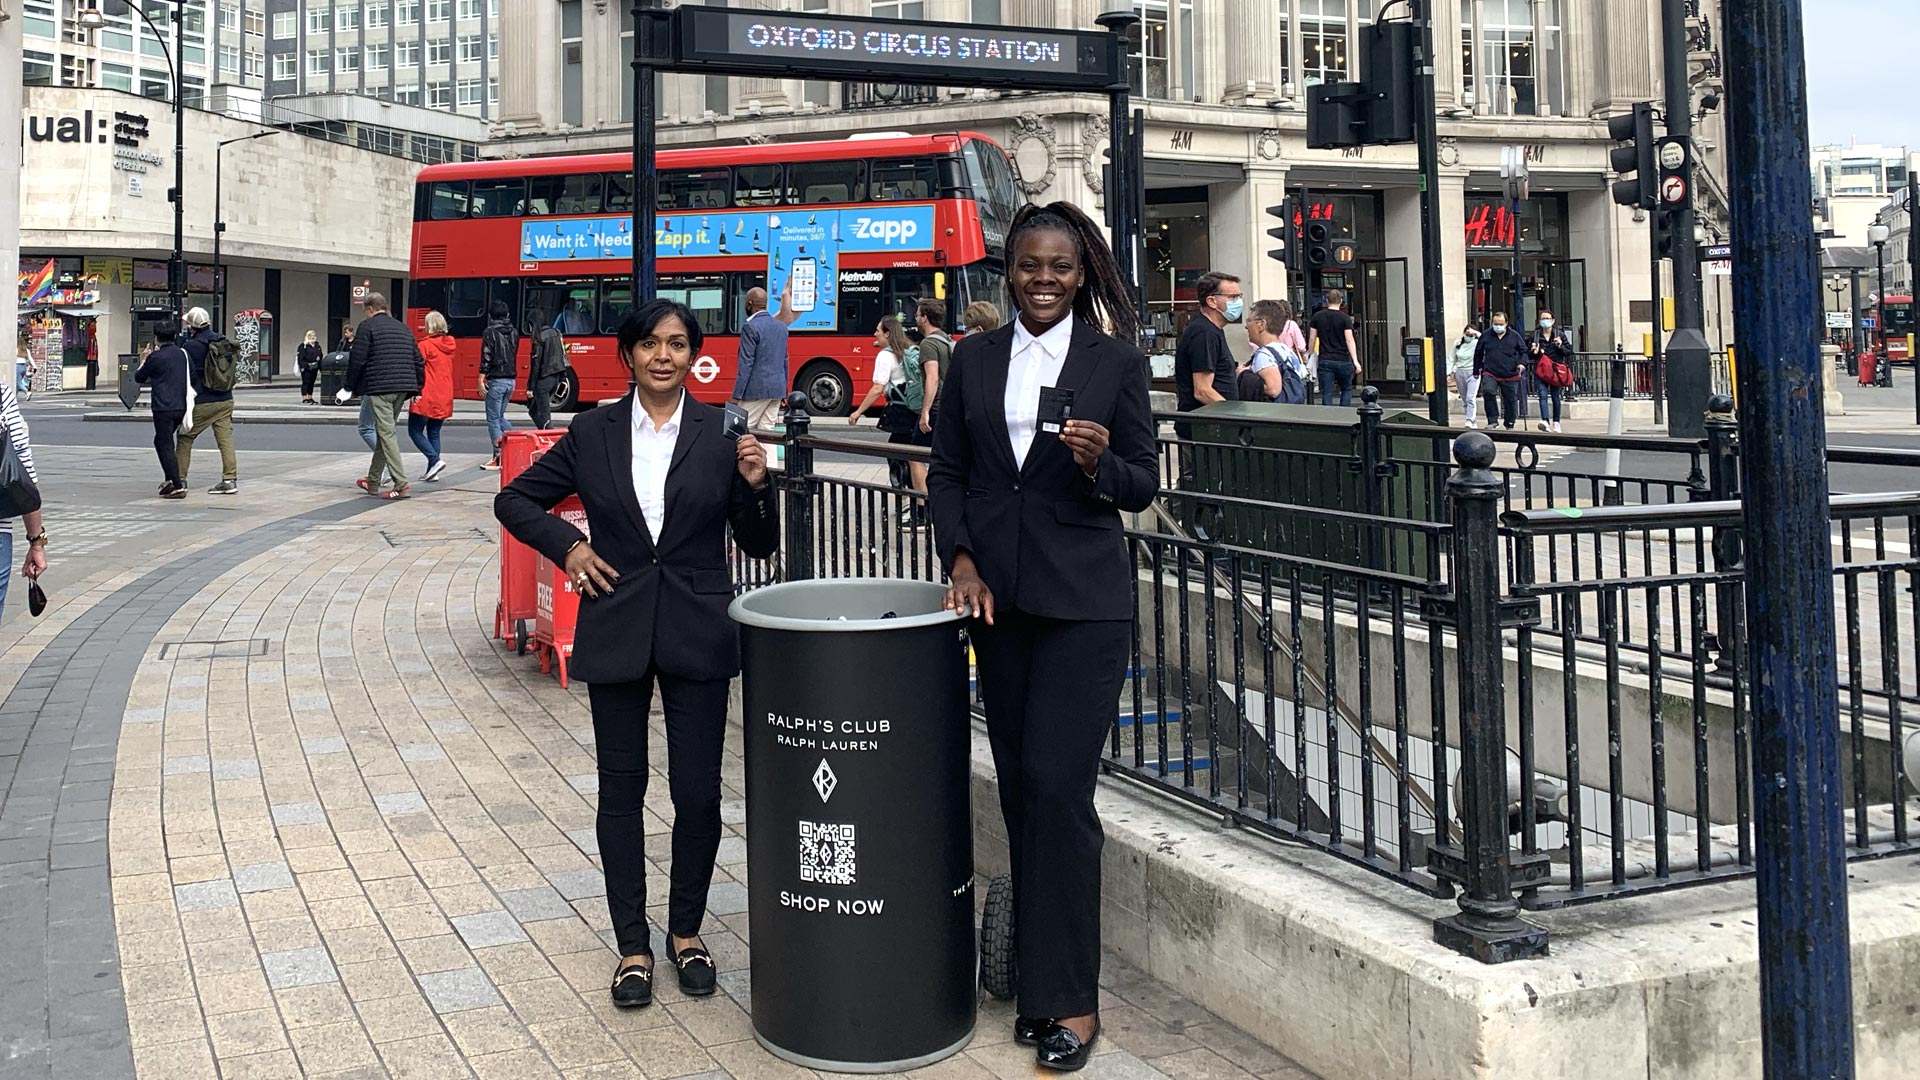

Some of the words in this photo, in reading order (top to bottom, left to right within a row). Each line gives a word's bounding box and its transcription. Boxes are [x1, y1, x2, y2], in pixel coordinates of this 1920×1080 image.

[747, 23, 857, 51] OXFORD
[863, 30, 952, 58] CIRCUS
[957, 36, 1060, 64] STATION
[29, 109, 107, 144] ual:
[1170, 130, 1193, 151] H&M
[783, 226, 817, 235] Delivered
[817, 226, 825, 234] in
[855, 217, 918, 245] Zapp
[1465, 204, 1515, 247] H&M
[534, 234, 572, 249] Want
[574, 232, 589, 248] it.
[593, 231, 632, 248] Need
[656, 230, 693, 249] Zapp
[695, 228, 710, 245] it.
[779, 234, 809, 242] minutes,
[839, 271, 884, 282] Metroline
[537, 582, 553, 613] FREE
[767, 712, 834, 734] RALPH'S
[840, 719, 891, 734] CLUB
[777, 734, 816, 749] RALPH
[822, 740, 879, 751] LAUREN
[780, 891, 831, 914] SHOP
[837, 899, 885, 915] NOW
